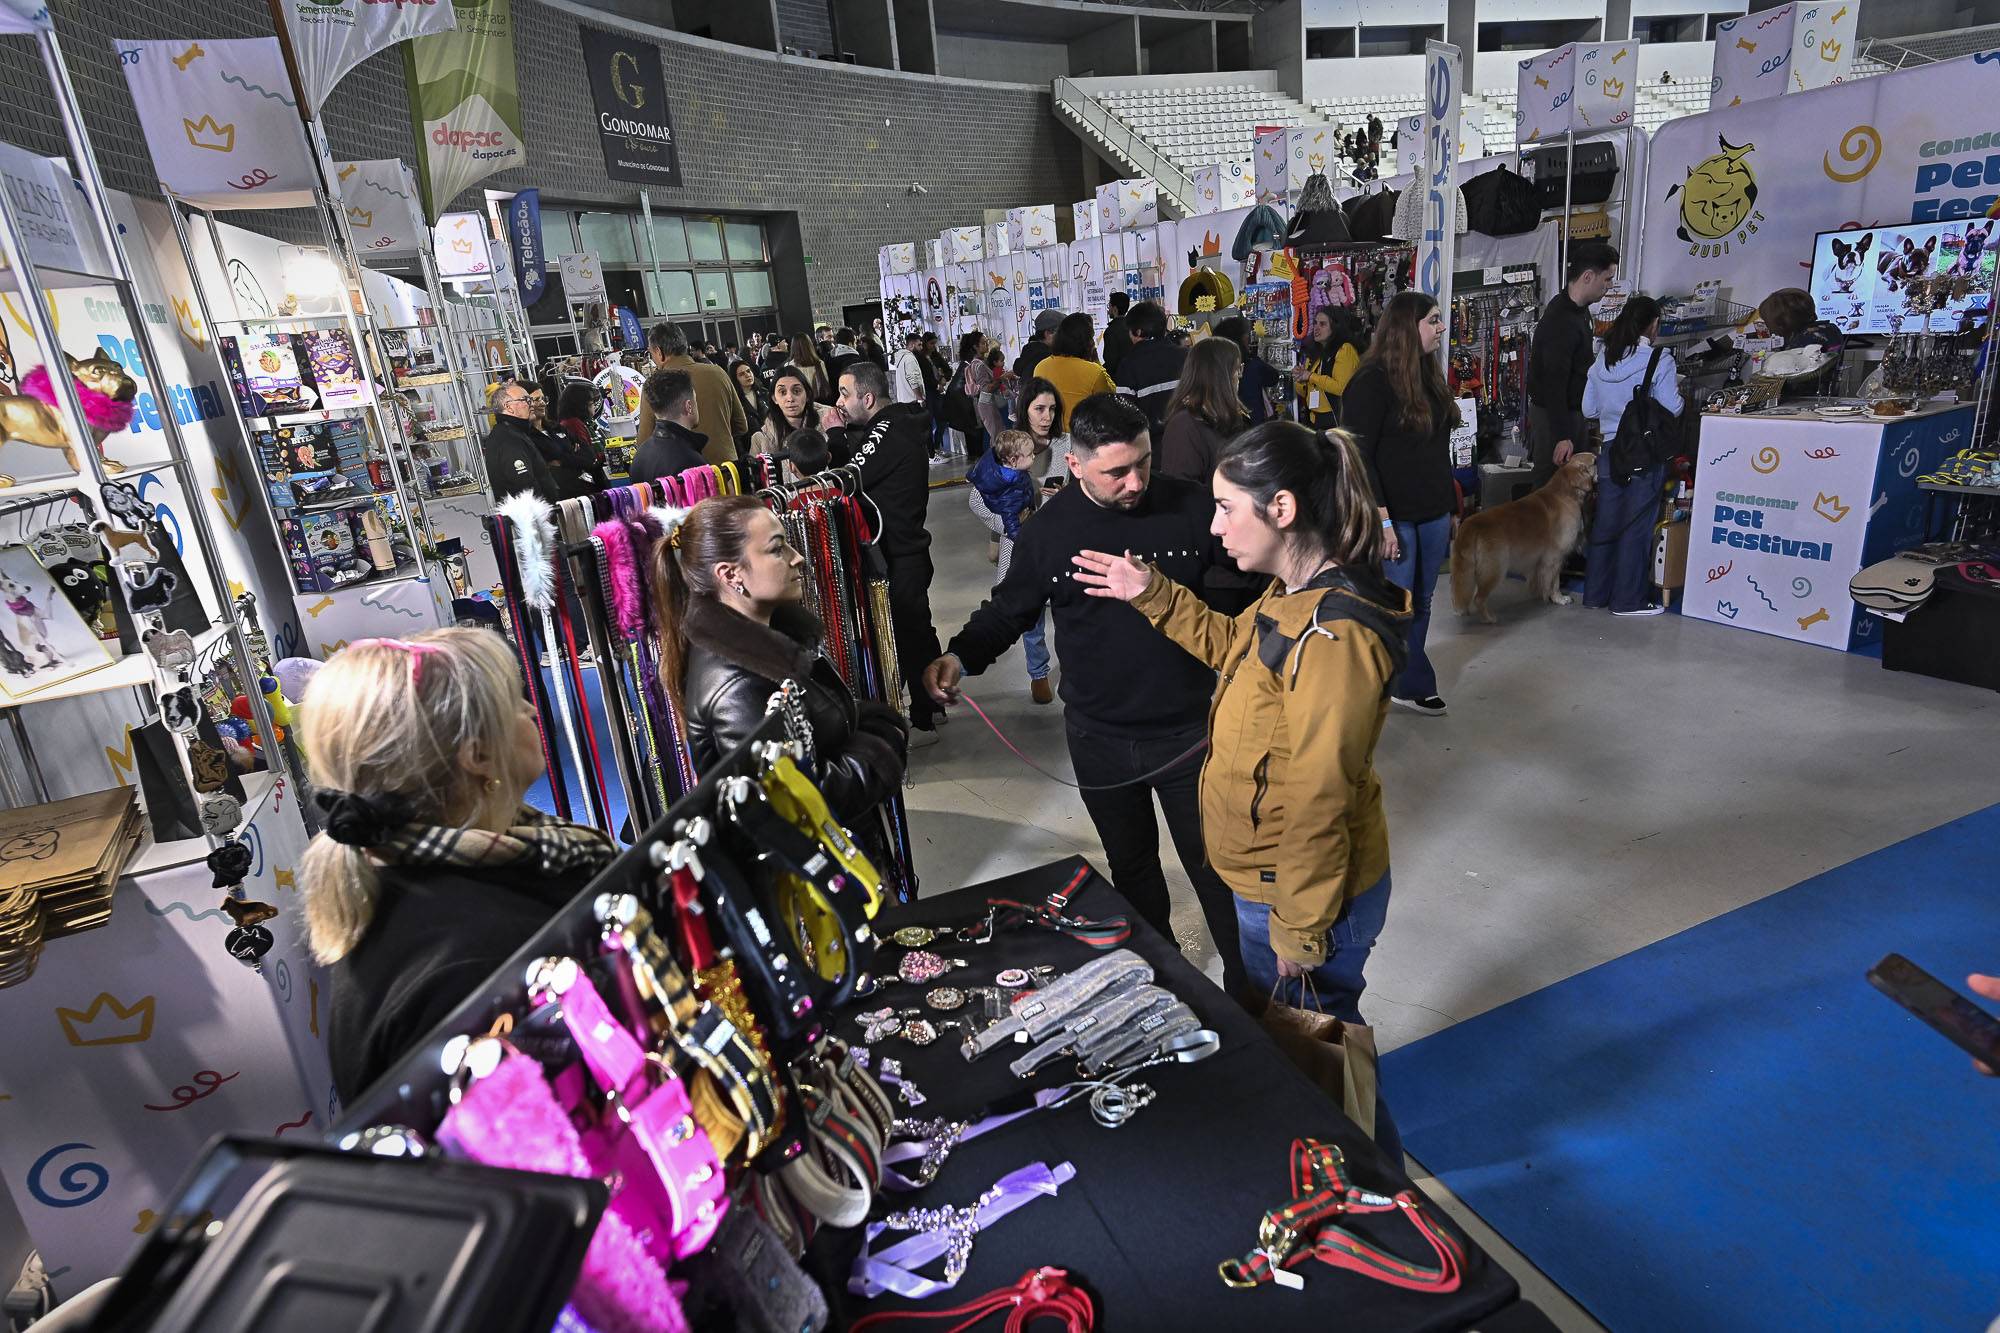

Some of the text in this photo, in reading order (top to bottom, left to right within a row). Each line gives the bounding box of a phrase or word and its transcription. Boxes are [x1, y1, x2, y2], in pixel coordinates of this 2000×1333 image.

[296, 3, 328, 16] Semente
[432, 122, 503, 152] dapac
[601, 112, 672, 141] GONDOMAR
[472, 148, 517, 161] dapac.es
[1689, 210, 1765, 259] RUDI PET
[1029, 286, 1043, 297] Pet
[97, 334, 145, 378] Pe
[1716, 490, 1799, 511] Gondomar
[1713, 505, 1764, 529] Pet
[1711, 526, 1833, 562] Festival
